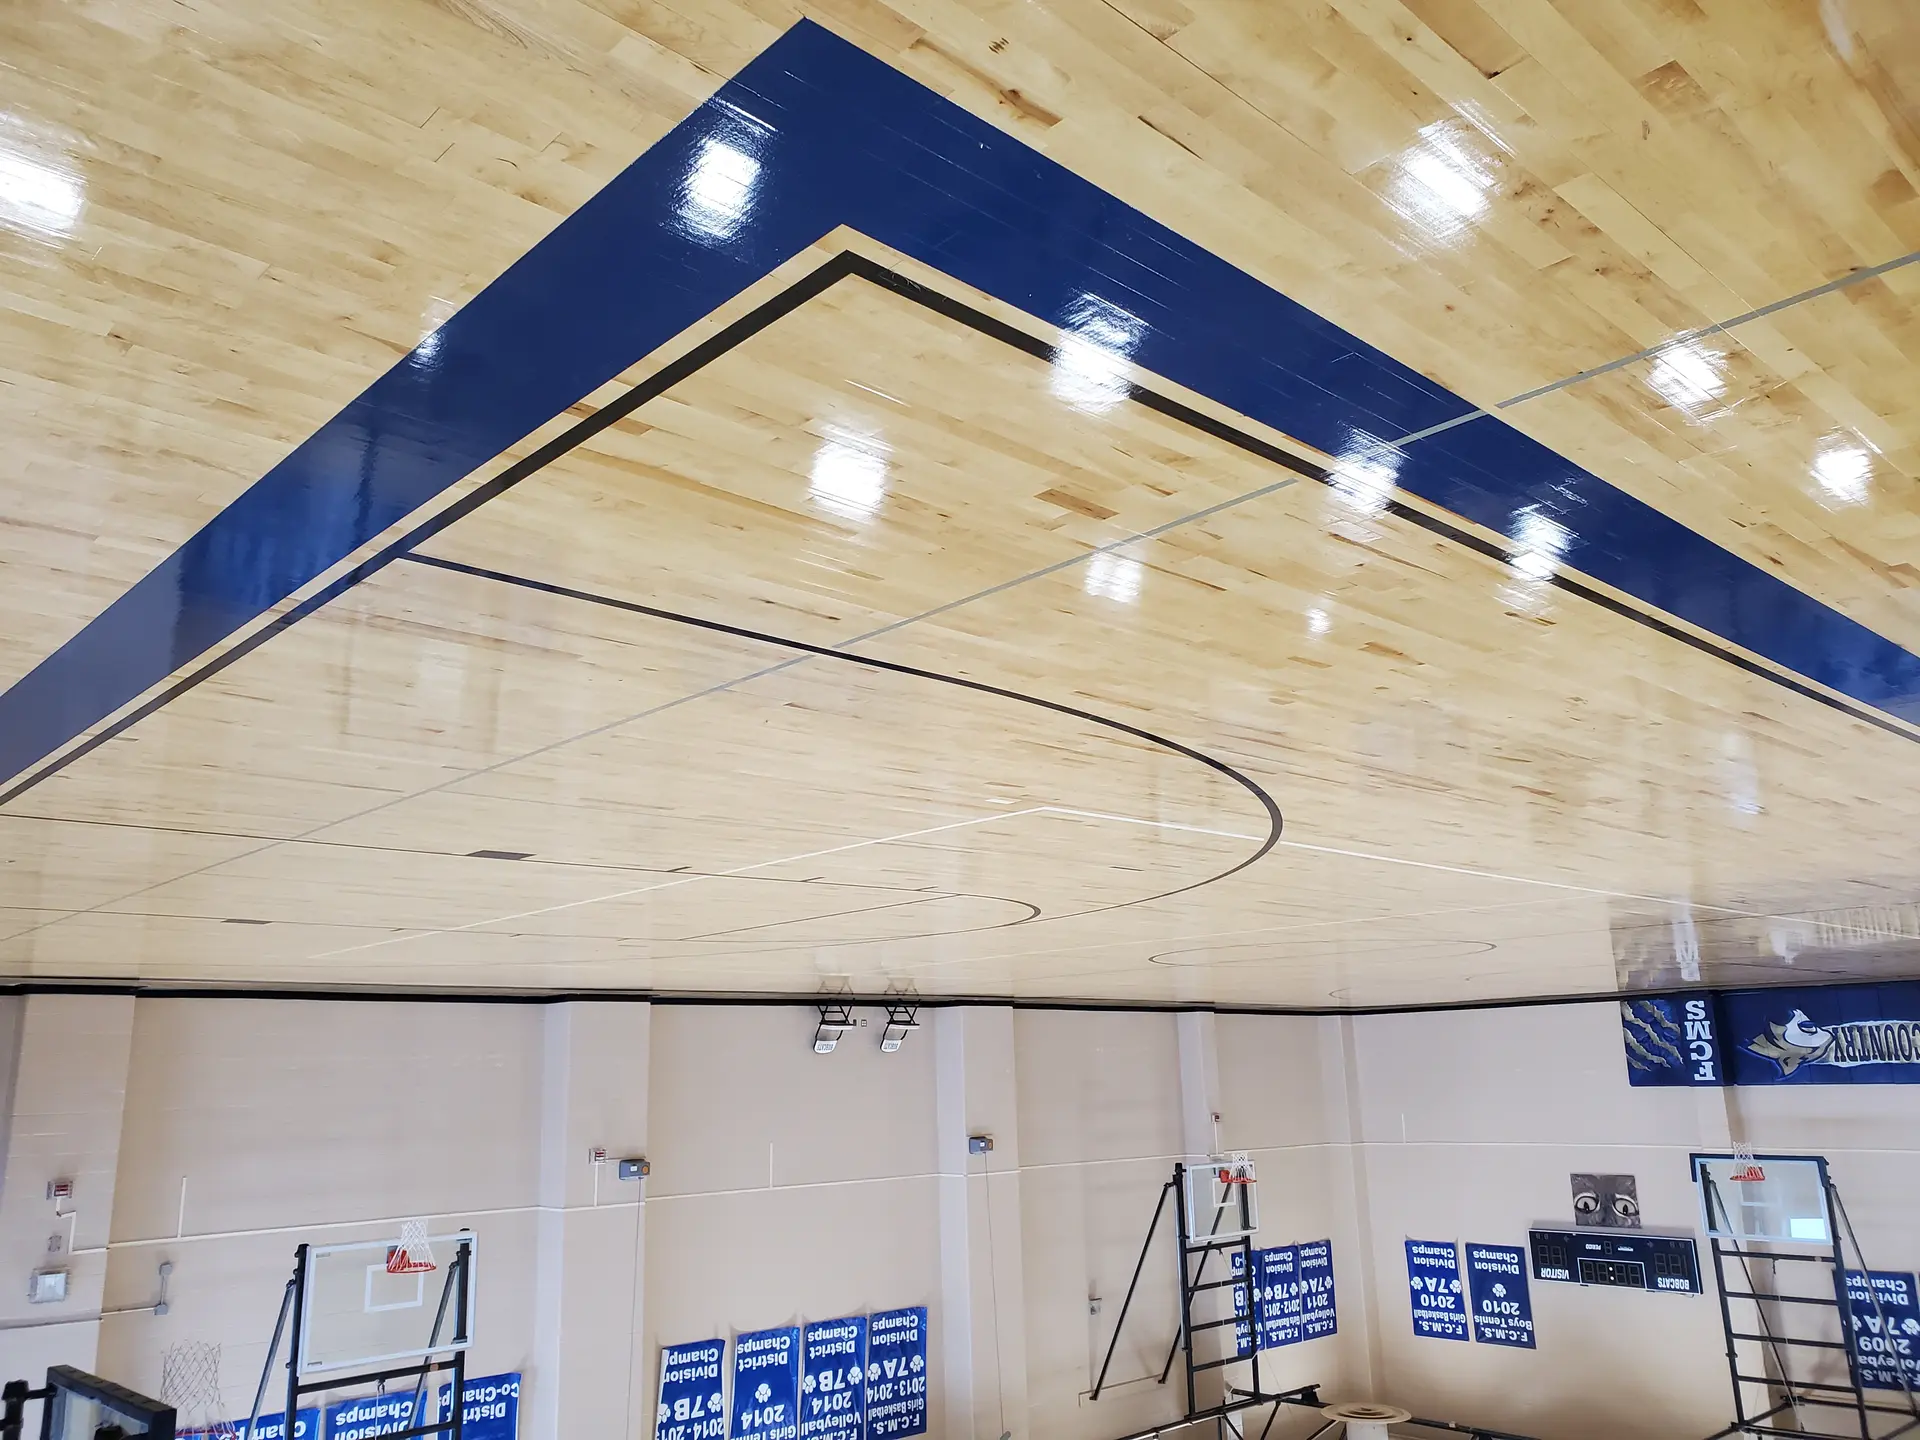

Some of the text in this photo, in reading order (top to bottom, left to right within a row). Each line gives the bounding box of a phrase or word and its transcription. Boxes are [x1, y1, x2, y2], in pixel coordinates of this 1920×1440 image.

[1684, 1000, 1716, 1080] FCMS
[1264, 1251, 1292, 1262] Champs
[1300, 1246, 1327, 1258] Champs
[1412, 1244, 1454, 1258] Champs
[1473, 1250, 1518, 1263] Champs
[1266, 1262, 1293, 1274] Division
[1301, 1257, 1328, 1268] Division
[1414, 1257, 1455, 1268] Division
[1474, 1262, 1519, 1274] Division
[1541, 1268, 1569, 1279] VISITOR
[1274, 1283, 1289, 1300] 7B
[1309, 1277, 1324, 1292] 7A
[1424, 1276, 1449, 1293] 7A
[1658, 1277, 1690, 1290] BOBCATS
[1846, 1276, 1907, 1291] Champs
[1264, 1299, 1300, 1317] 2012-2013
[1307, 1293, 1328, 1309] 2011
[1420, 1294, 1455, 1309] 2010
[1483, 1300, 1520, 1315] 2010
[872, 1315, 918, 1331] Champs
[1290, 1315, 1300, 1325] Girls
[1302, 1308, 1335, 1323] Volleyball
[1413, 1309, 1466, 1323] Girls Basketball
[1474, 1315, 1532, 1330] Boys Tennis
[1265, 1317, 1290, 1331] Basketball
[1306, 1319, 1333, 1333] F.C.M.S.
[1419, 1321, 1463, 1334] F.C.M.S.
[1863, 1315, 1900, 1336] 7A
[808, 1326, 857, 1342] Champs
[872, 1329, 918, 1345] Division
[1270, 1327, 1298, 1341] F.C.M.S.
[1481, 1327, 1528, 1342] F.C.M.S.
[737, 1336, 790, 1354] Champs
[809, 1340, 855, 1360] District
[1859, 1336, 1910, 1354] 2009
[666, 1348, 718, 1366] Champ
[738, 1351, 788, 1372] District
[883, 1356, 909, 1379] 7A
[818, 1368, 845, 1392] 7B
[438, 1383, 520, 1407] Co-Chap
[866, 1376, 925, 1404] 2013-2014
[674, 1395, 705, 1421] 7B
[812, 1391, 852, 1415] 2014
[867, 1398, 924, 1421] Girls Basketball
[335, 1401, 414, 1426] Champs
[446, 1402, 506, 1424] Distri
[741, 1404, 785, 1430] 2014
[801, 1411, 861, 1436] Volleyball
[873, 1414, 920, 1434] F.C.M.S.
[770, 1425, 796, 1440] Girls
